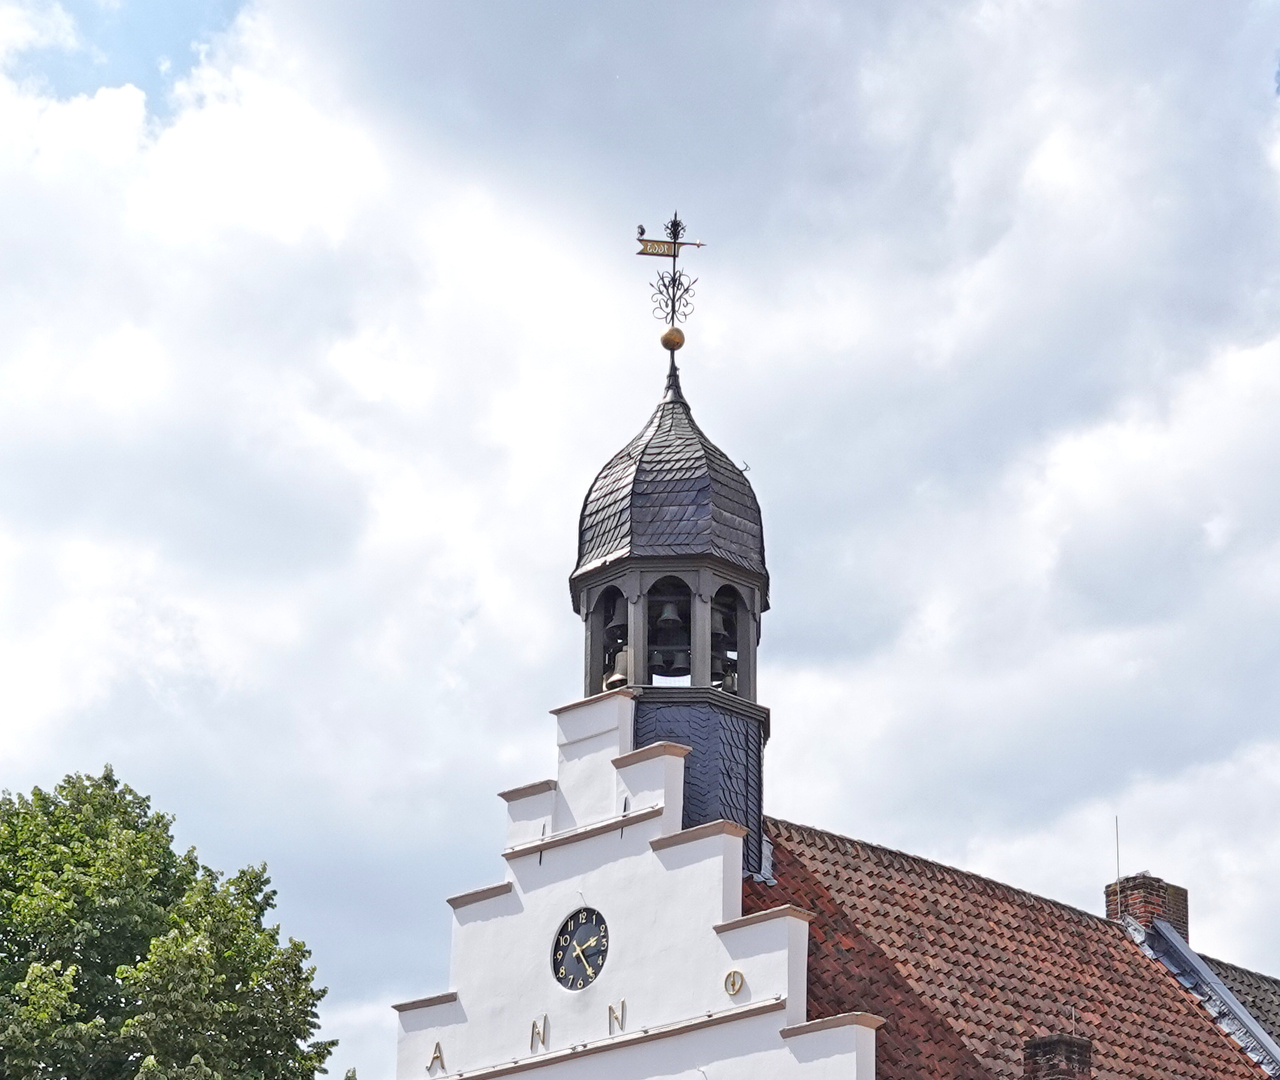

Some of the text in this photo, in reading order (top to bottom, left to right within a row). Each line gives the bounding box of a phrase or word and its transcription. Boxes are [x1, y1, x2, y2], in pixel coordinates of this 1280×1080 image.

[579, 911, 587, 924] 12
[592, 914, 596, 925] 1
[567, 920, 574, 931] 11
[600, 924, 606, 936] 2
[559, 934, 570, 946] 10
[601, 938, 608, 950] 3
[556, 950, 563, 962] 9
[597, 955, 603, 966] 4
[559, 966, 565, 978] 8
[567, 974, 574, 988] 7
[577, 976, 584, 988] 6
